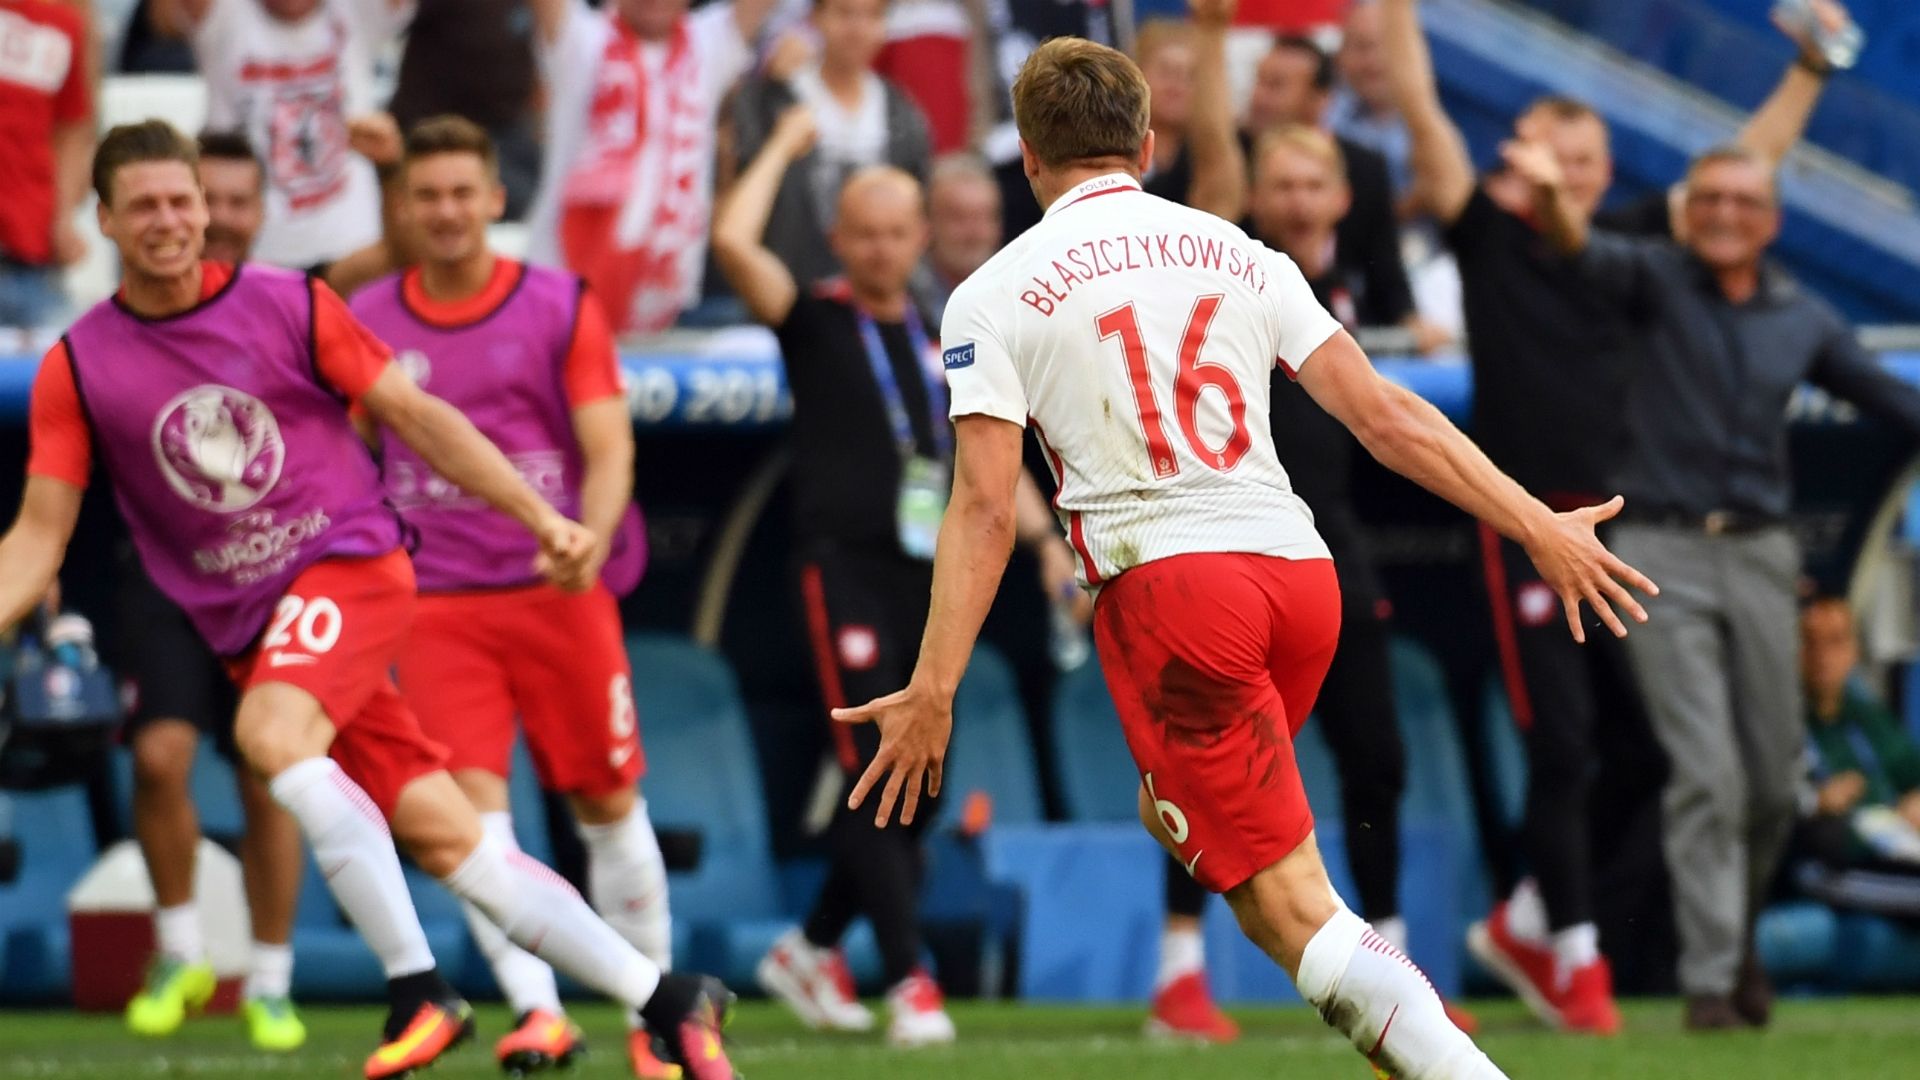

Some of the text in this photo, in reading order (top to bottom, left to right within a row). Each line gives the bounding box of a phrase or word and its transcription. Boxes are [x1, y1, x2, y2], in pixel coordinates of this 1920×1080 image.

[1080, 178, 1118, 194] POLSKA
[683, 367, 795, 425] 201
[1094, 293, 1252, 481] 16
[262, 594, 343, 654] 20
[607, 672, 635, 740] 8
